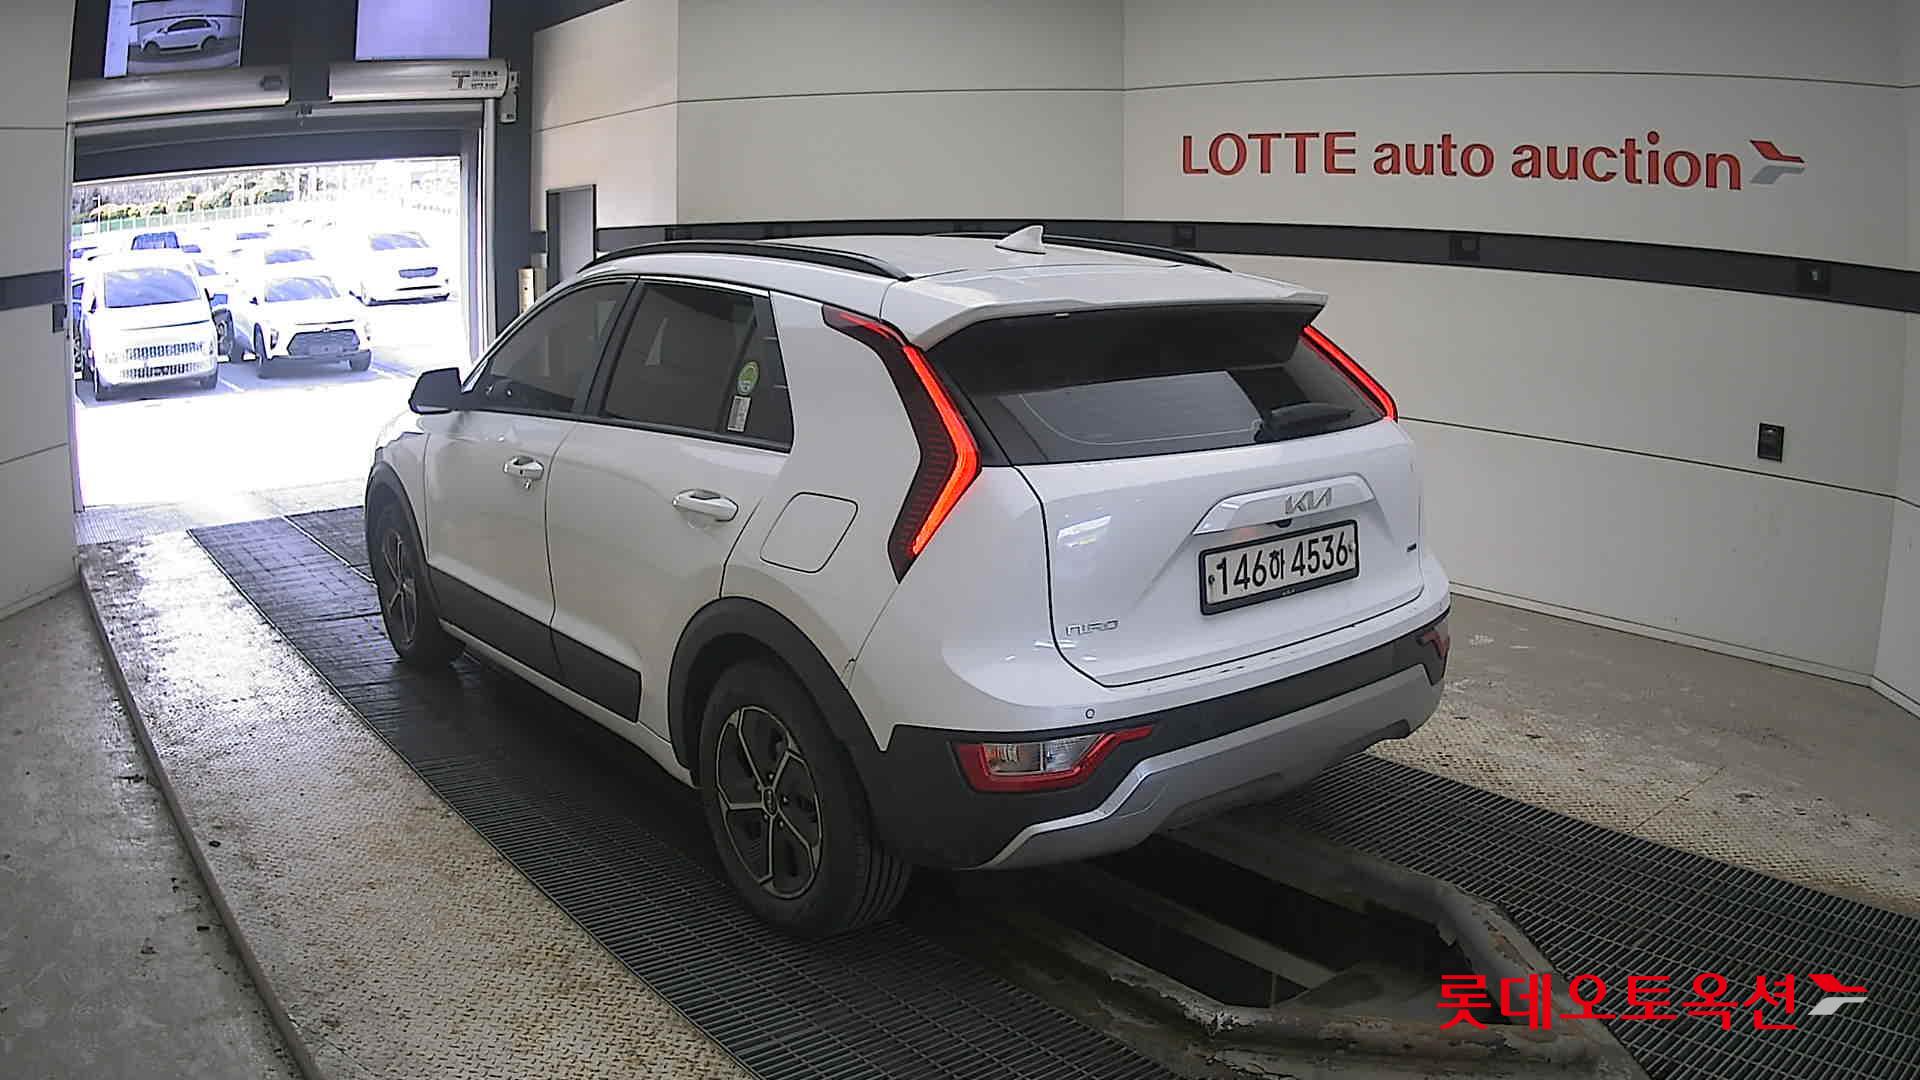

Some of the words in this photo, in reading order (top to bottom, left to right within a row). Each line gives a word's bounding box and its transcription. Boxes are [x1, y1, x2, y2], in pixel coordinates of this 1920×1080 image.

[1181, 131, 1357, 176] LOTTE
[1373, 132, 1495, 178] auto
[1511, 130, 1743, 191] auction
[1284, 487, 1333, 515] KIA
[1215, 547, 1286, 596] 146하
[1291, 530, 1349, 577] 4536
